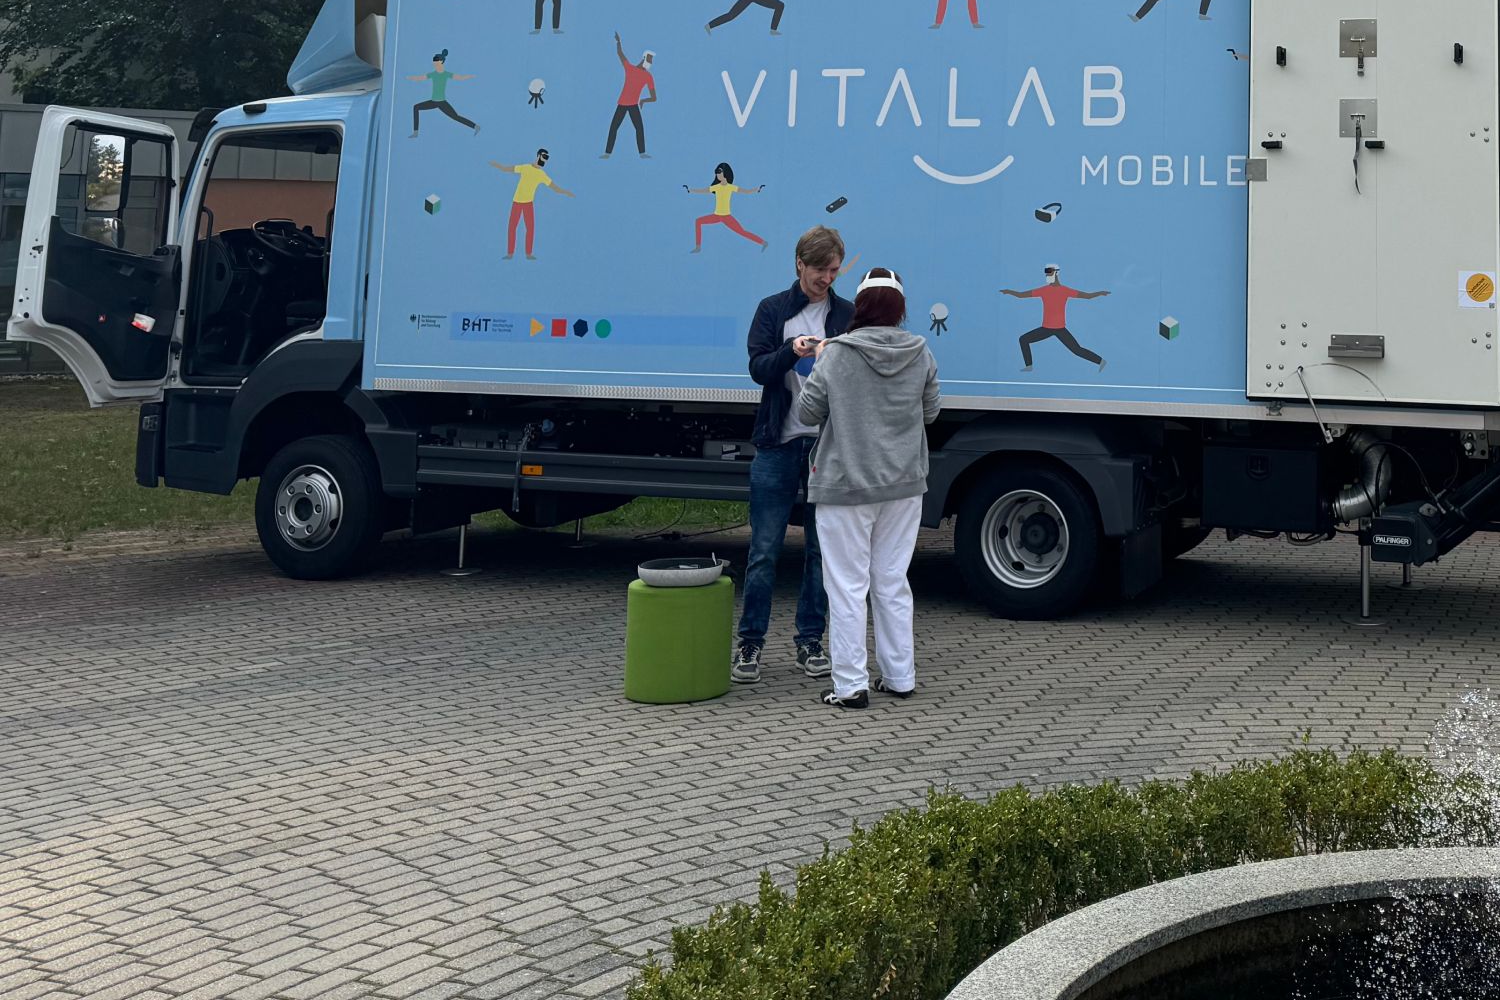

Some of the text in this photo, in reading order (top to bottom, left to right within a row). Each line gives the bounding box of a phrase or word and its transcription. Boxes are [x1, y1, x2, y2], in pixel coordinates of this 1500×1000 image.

[721, 65, 1127, 128] VITALAB
[1080, 154, 1247, 187] MOBILE
[461, 316, 491, 333] BHT
[1375, 536, 1409, 545] PALFINGER
